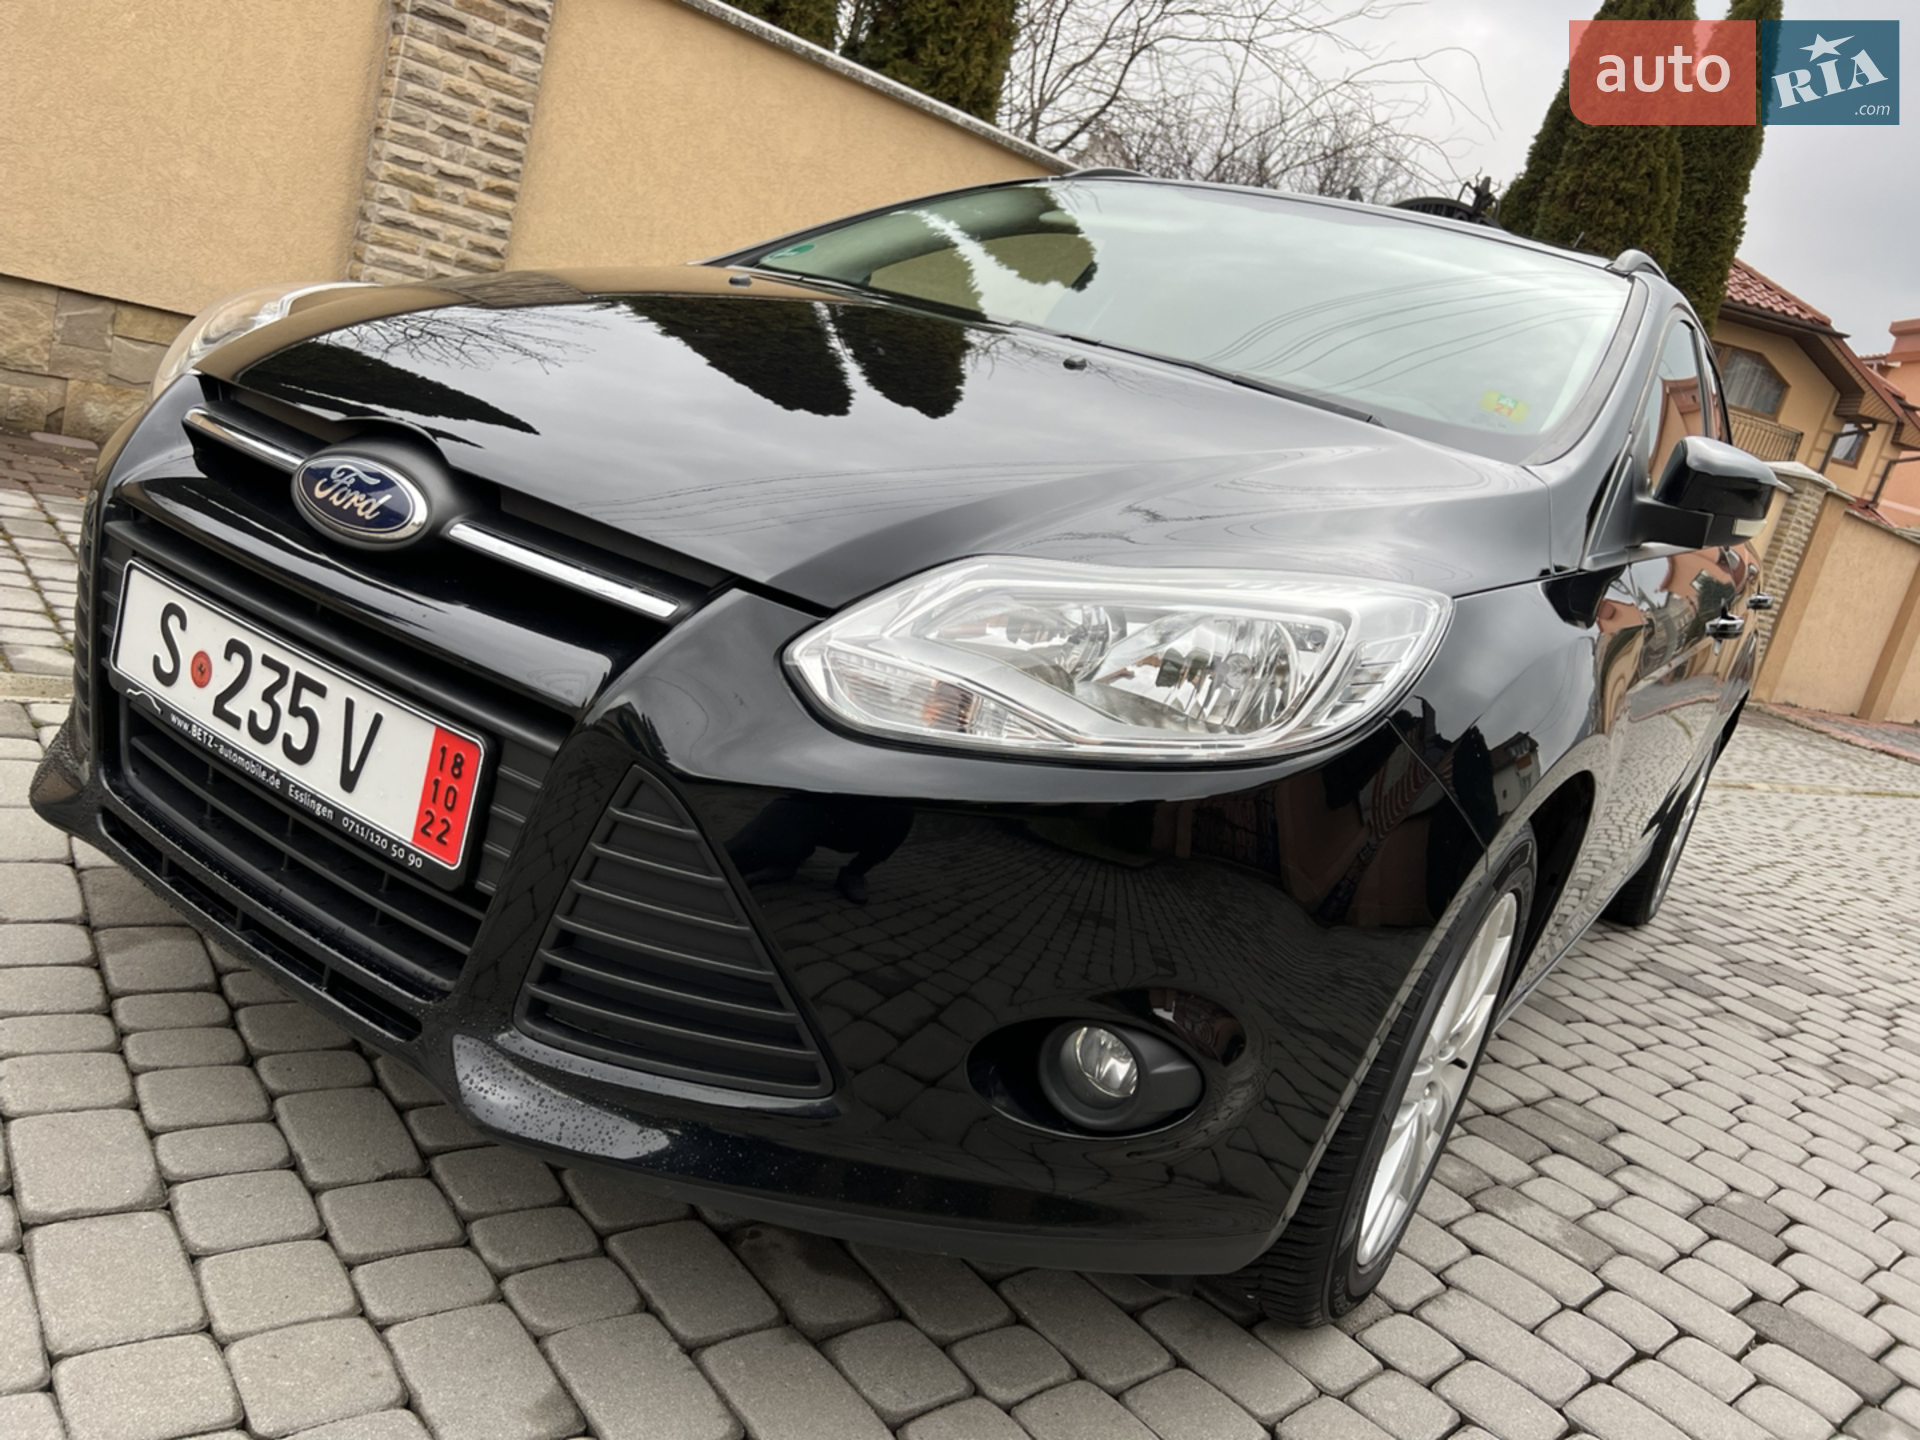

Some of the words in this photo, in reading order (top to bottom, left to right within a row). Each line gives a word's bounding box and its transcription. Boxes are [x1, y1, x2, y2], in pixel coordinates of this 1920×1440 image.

[314, 464, 393, 520] Ford
[152, 602, 188, 688] S
[212, 638, 328, 766] 235
[339, 696, 384, 794] V
[440, 745, 465, 779] 18
[170, 712, 281, 789] www.BETZ-automobile.de
[288, 783, 334, 821] Esslingen
[341, 816, 388, 849] 0711/120
[390, 843, 405, 859] 50
[407, 852, 423, 869] 90
[431, 777, 457, 811] 10
[420, 809, 452, 846] 22
